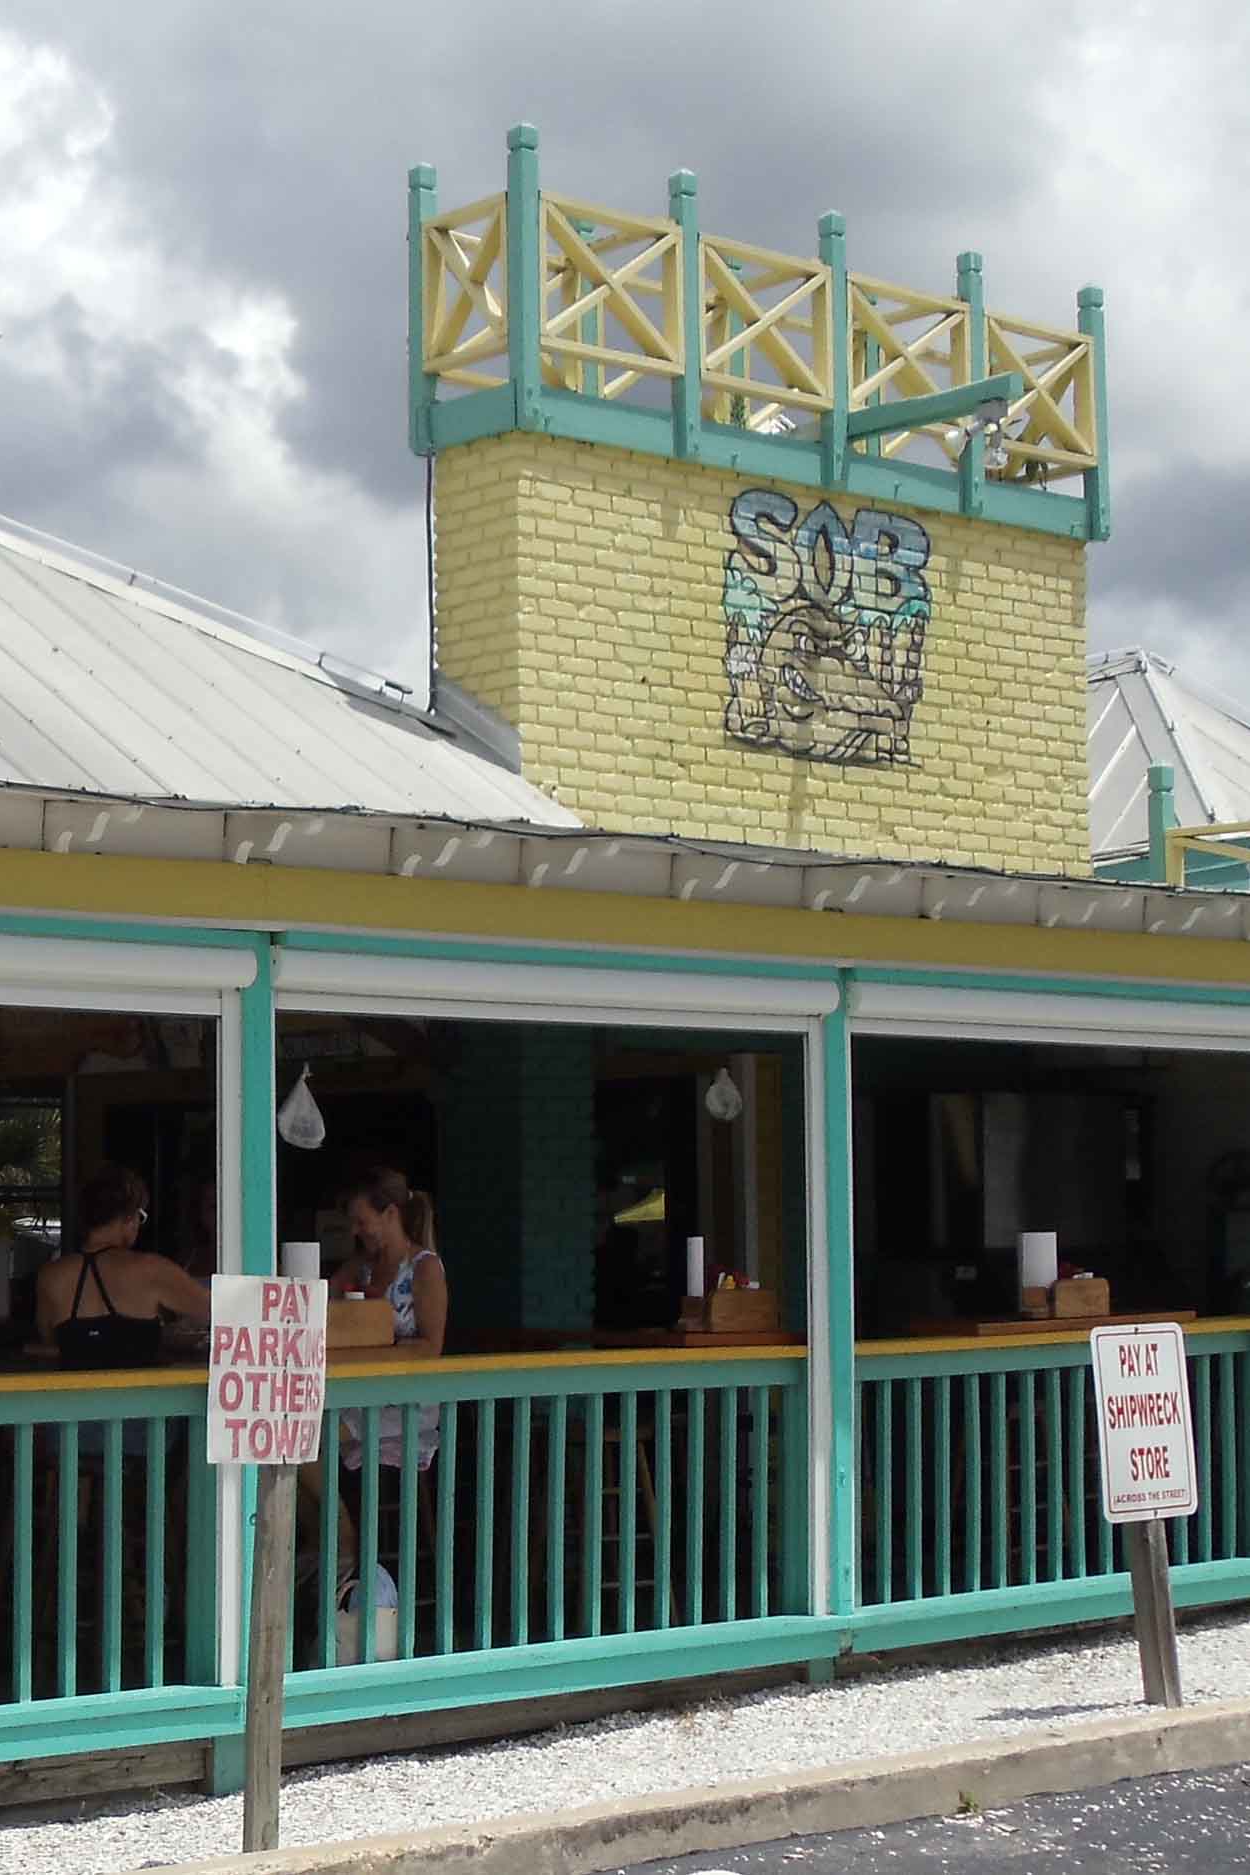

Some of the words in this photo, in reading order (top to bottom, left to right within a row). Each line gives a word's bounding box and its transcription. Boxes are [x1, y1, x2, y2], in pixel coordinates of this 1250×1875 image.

[729, 488, 931, 611] SOB
[261, 1282, 311, 1323] PAY
[213, 1326, 325, 1367] PARKING
[1118, 1344, 1141, 1377] PAY
[1145, 1343, 1158, 1376] AT
[218, 1371, 320, 1413] OTHERS
[1107, 1391, 1181, 1430] SHIPWRECK
[224, 1418, 317, 1458] TOWED
[1130, 1446, 1170, 1482] STORE
[1148, 1490, 1160, 1501] THE
